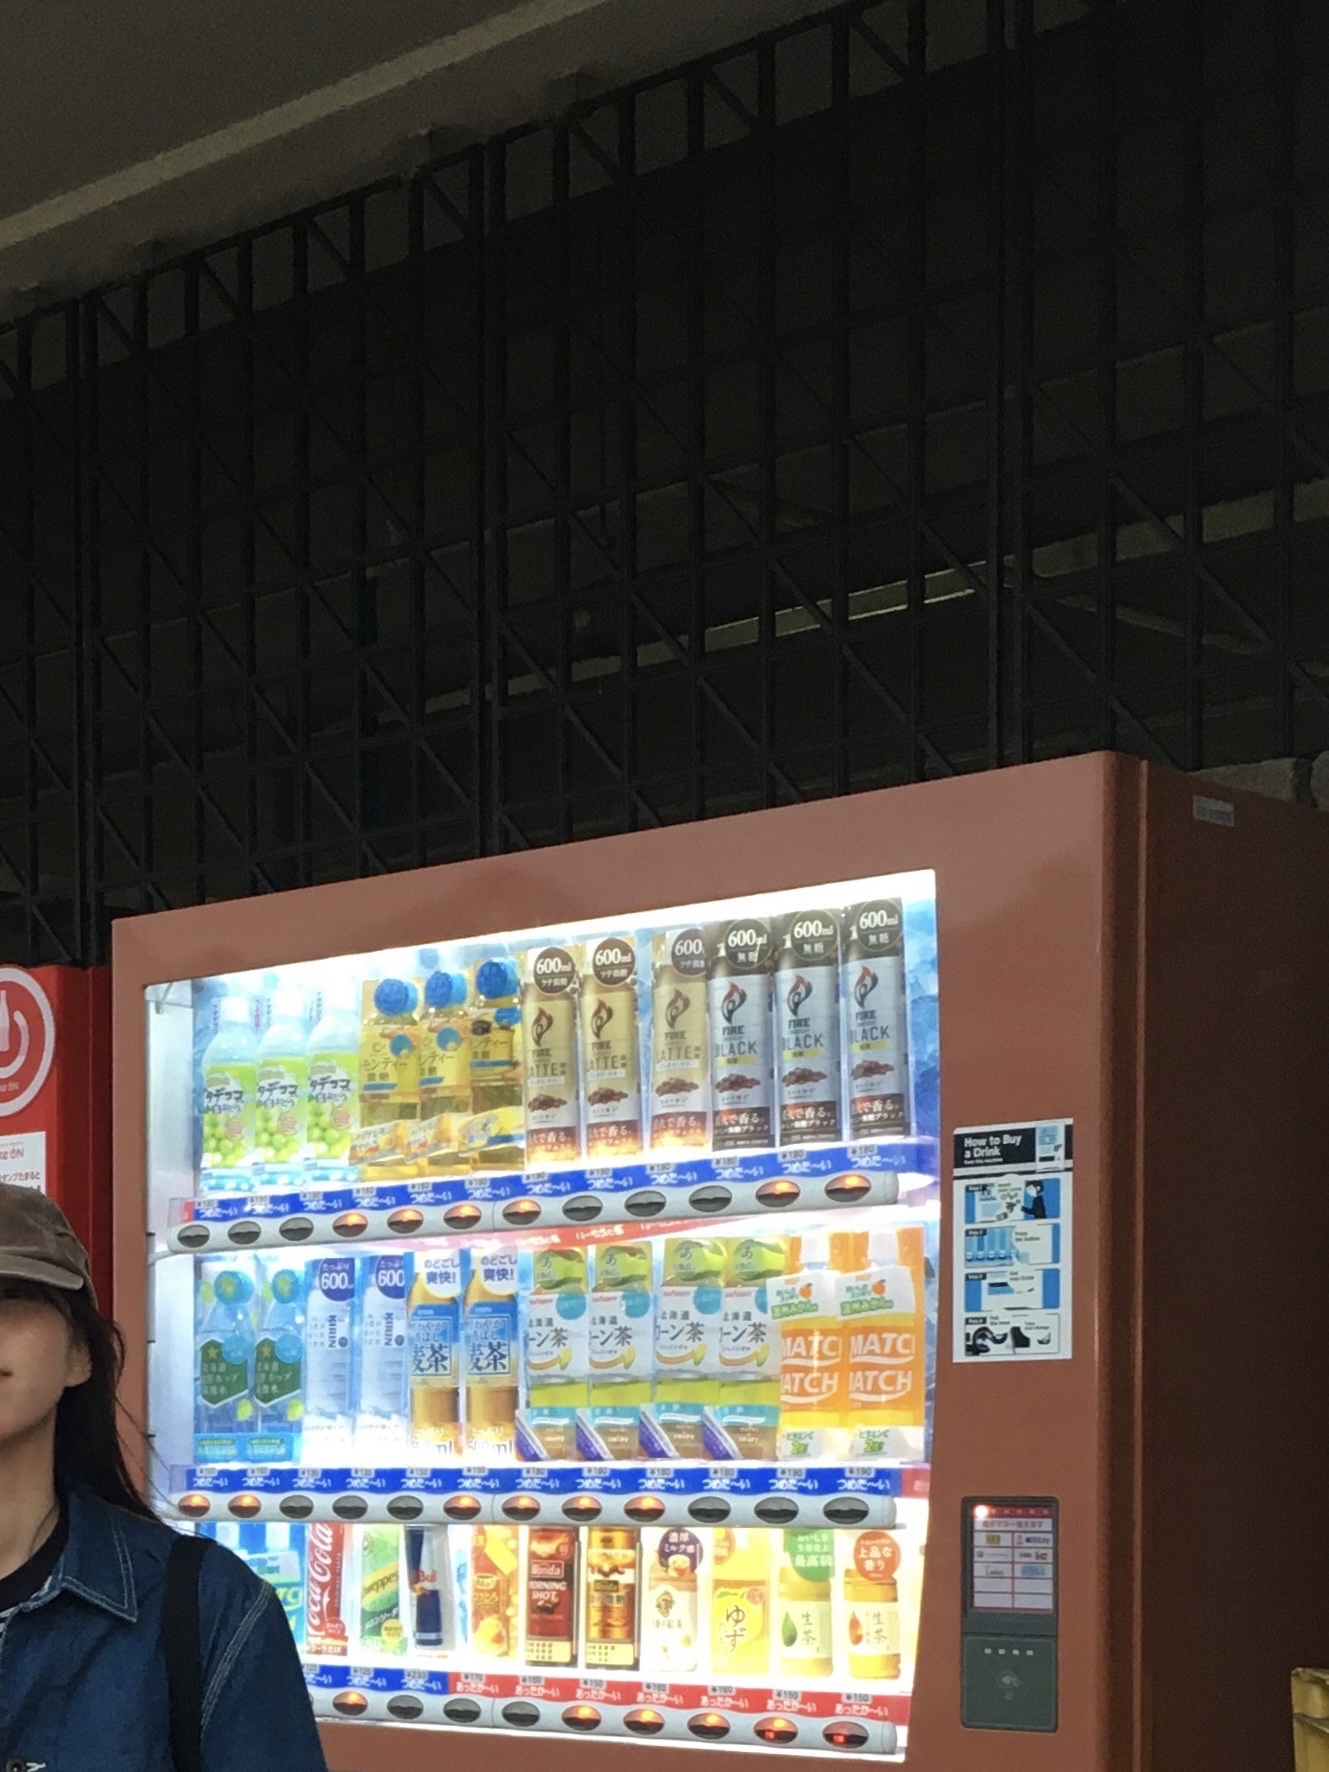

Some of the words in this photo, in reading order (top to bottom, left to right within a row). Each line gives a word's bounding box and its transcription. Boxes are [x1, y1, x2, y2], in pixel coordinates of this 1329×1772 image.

[860, 910, 898, 929] 600ml
[794, 920, 833, 938] 600ml
[536, 957, 572, 974] 600ml
[595, 949, 631, 965] 600ml
[788, 1018, 810, 1028] FIRE
[855, 1010, 877, 1021] FIRE
[722, 1025, 745, 1036] FIRE
[964, 1137, 987, 1148] How
[989, 1136, 1001, 1146] to
[1002, 1134, 1022, 1146] Buy
[9, 1147, 25, 1160] ON
[964, 1150, 971, 1159] a
[973, 1146, 1001, 1158] Drink
[328, 1315, 338, 1348] KIRIN
[384, 1312, 394, 1347] KIRIN
[589, 1326, 633, 1347] ーン茶
[719, 1322, 768, 1344] ーン茶
[782, 1335, 842, 1357] MATC
[849, 1333, 915, 1355] MATC
[858, 1546, 893, 1559] 上品な
[725, 1604, 746, 1653] ゆず
[801, 1611, 817, 1646] 生茶
[872, 1611, 887, 1645] 生茶
[776, 1690, 800, 1700] ¥150
[846, 1693, 870, 1703] ¥150
